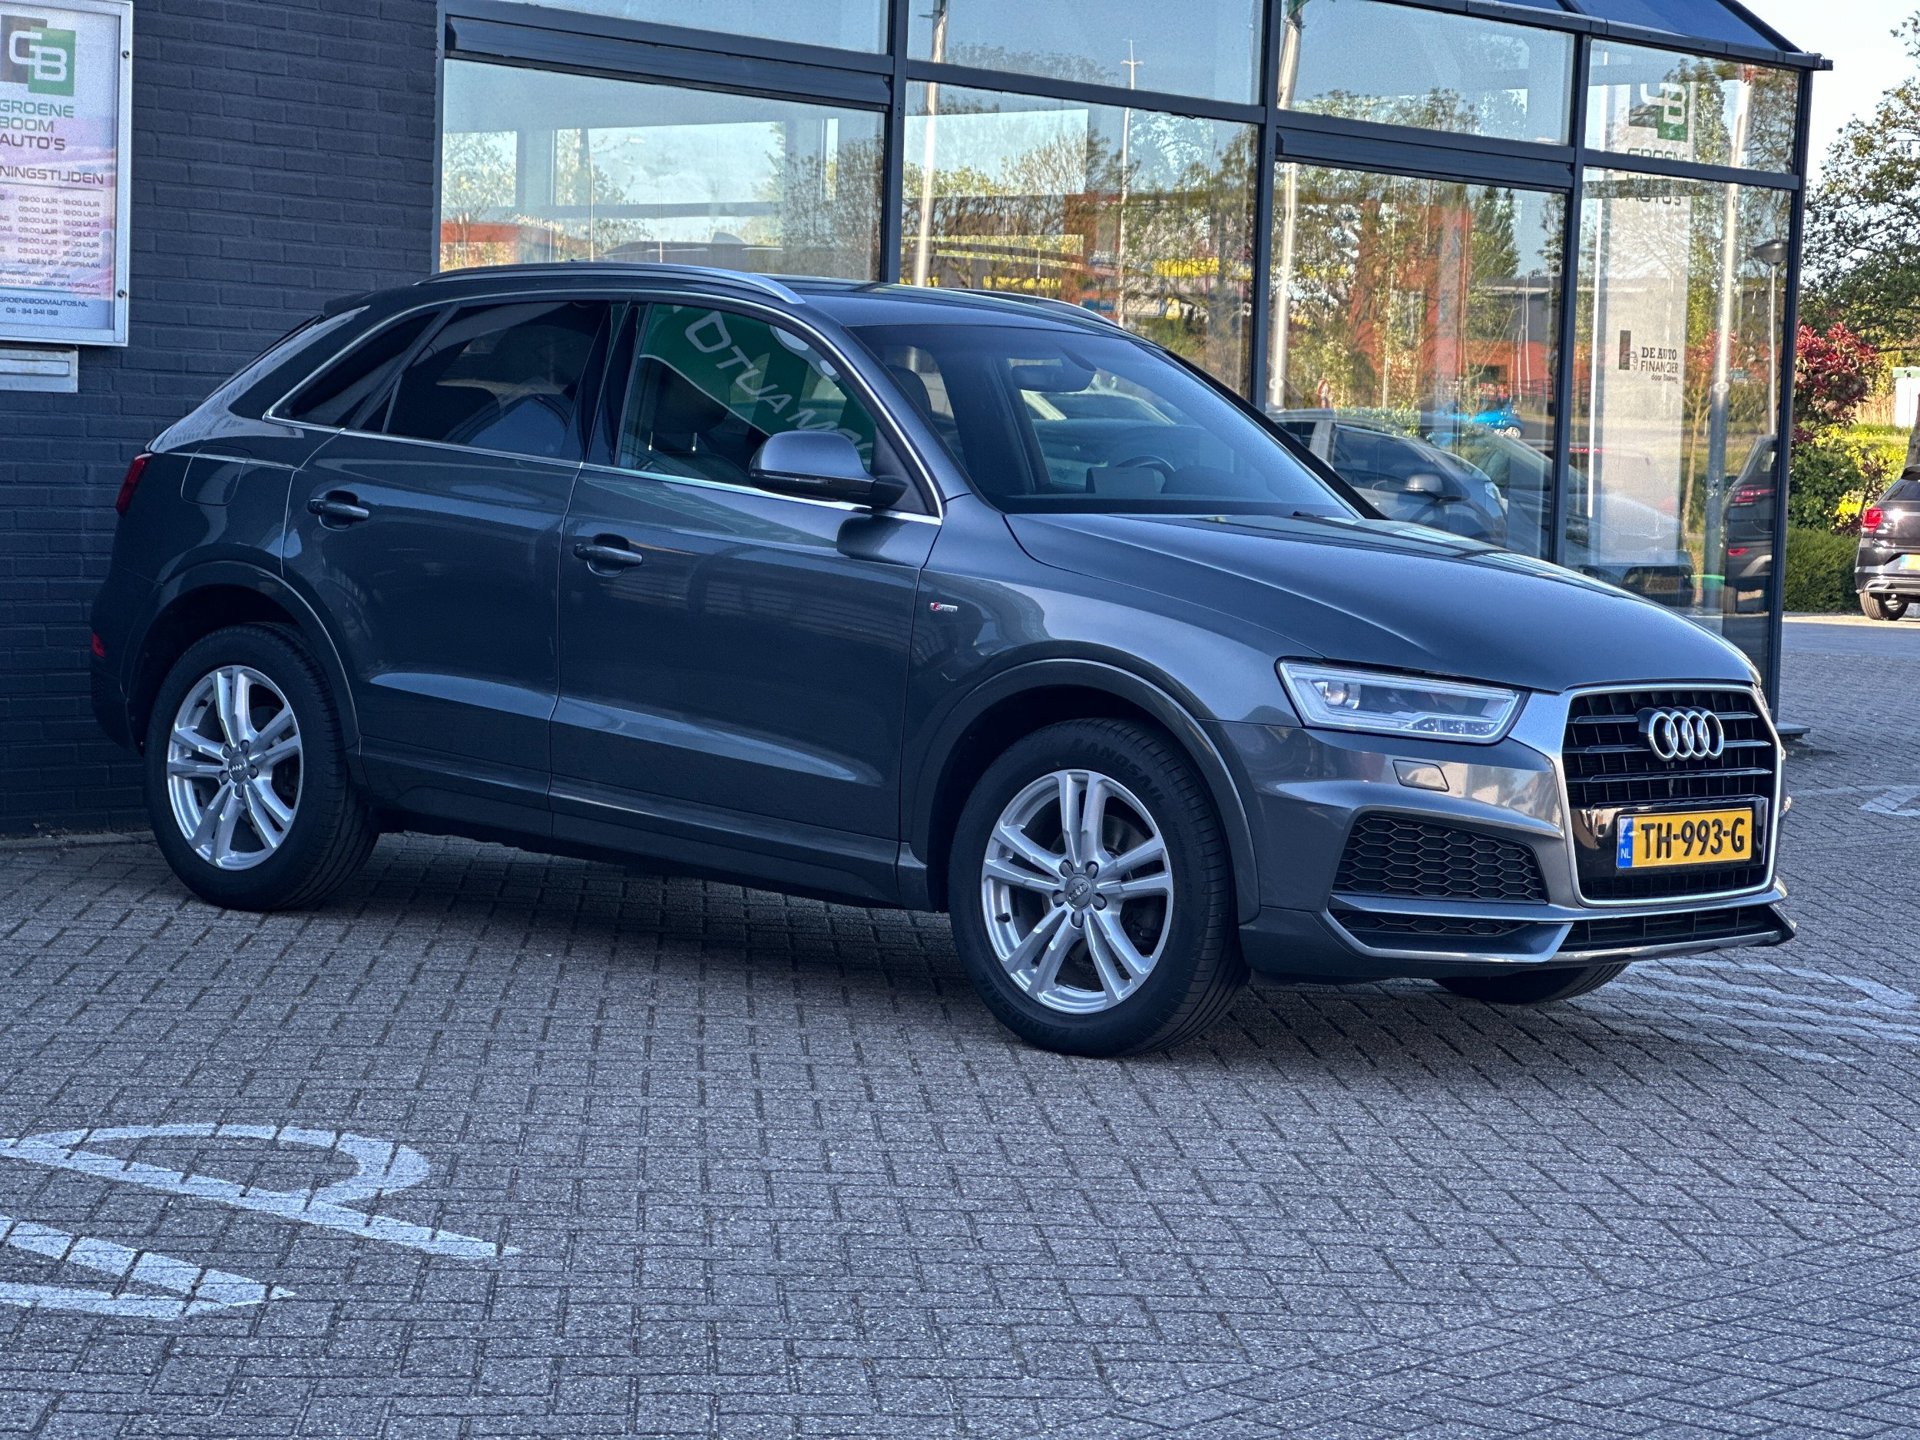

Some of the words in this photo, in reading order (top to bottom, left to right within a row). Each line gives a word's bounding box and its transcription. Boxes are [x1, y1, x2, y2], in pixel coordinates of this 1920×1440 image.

[0, 99, 75, 119] GROENE
[0, 133, 66, 151] AUTO'S
[1641, 346, 1656, 359] DE
[1657, 347, 1677, 360] AUTO
[1620, 847, 1632, 860] NL
[1640, 817, 1746, 860] TH-993-G
